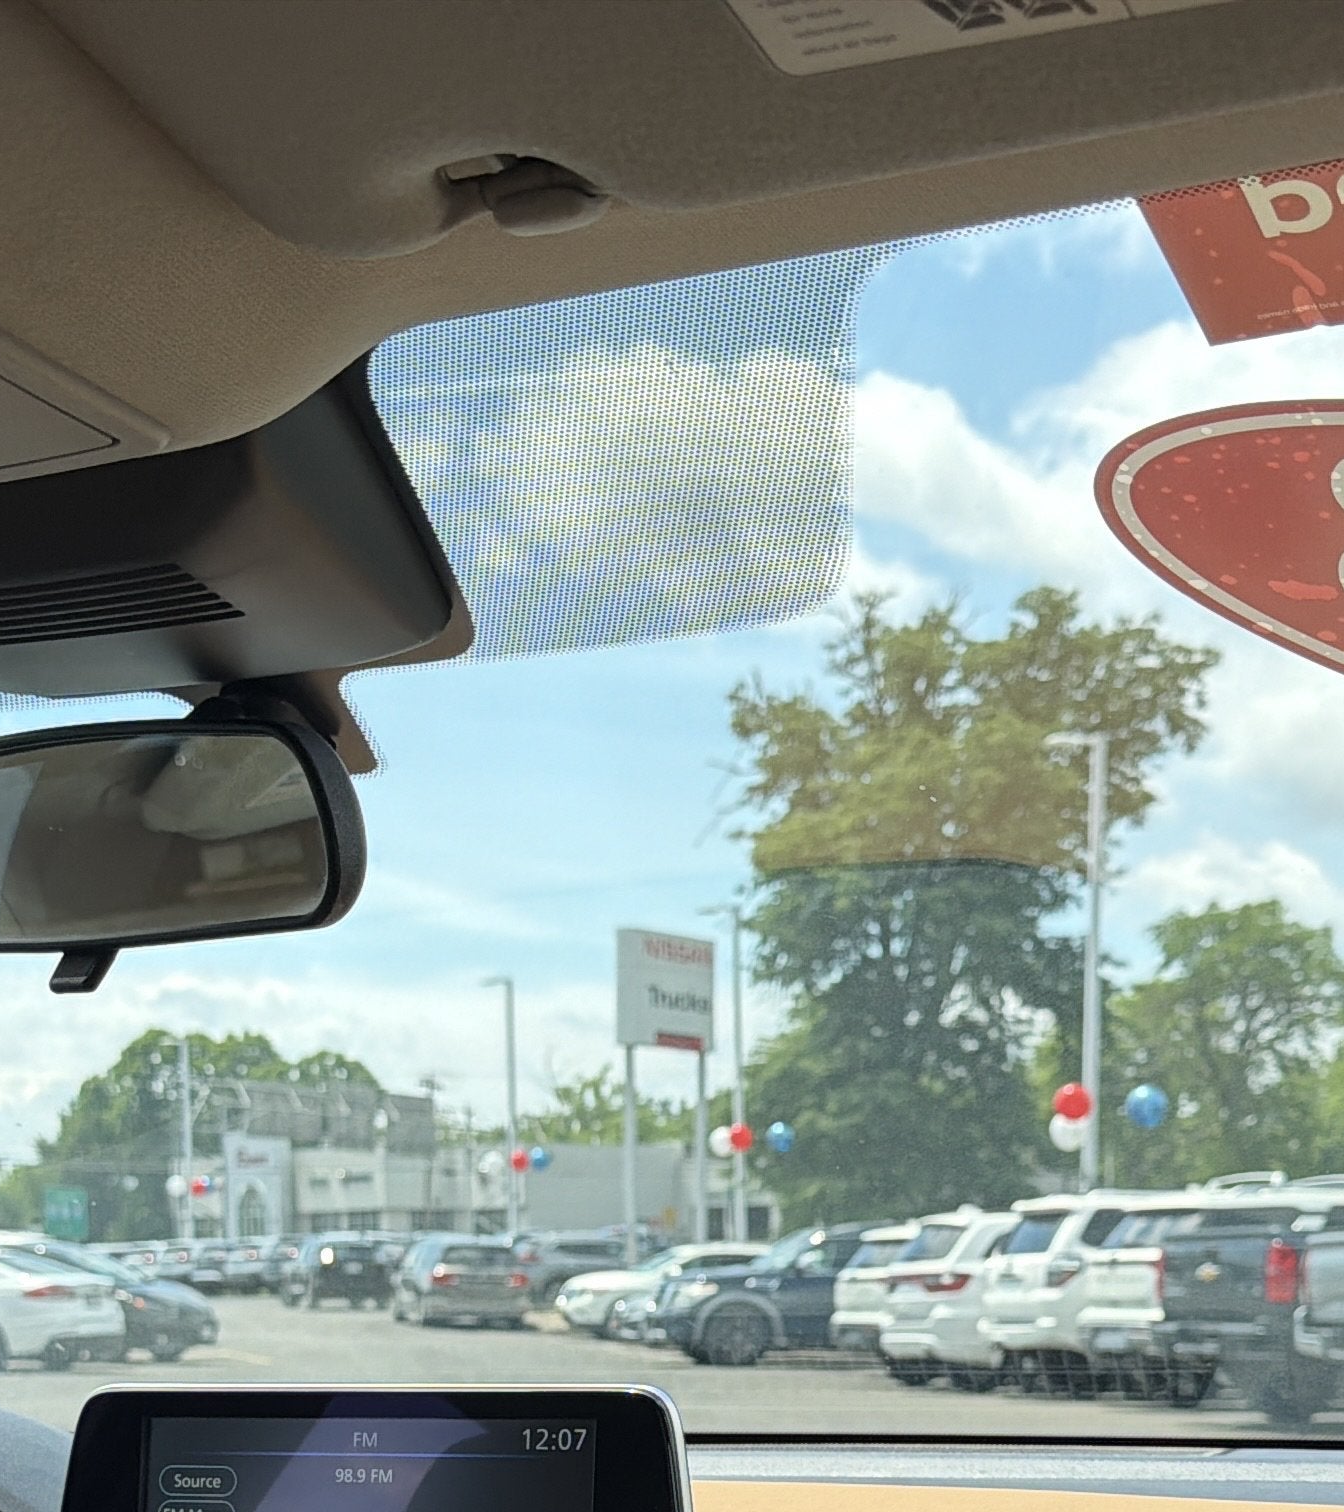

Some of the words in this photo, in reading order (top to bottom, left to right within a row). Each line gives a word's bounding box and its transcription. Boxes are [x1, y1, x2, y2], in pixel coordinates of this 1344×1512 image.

[354, 1432, 378, 1448] FM
[521, 1428, 587, 1451] 12:07
[174, 1474, 221, 1490] Source
[335, 1468, 367, 1484] 98.9
[370, 1469, 393, 1484] FM
